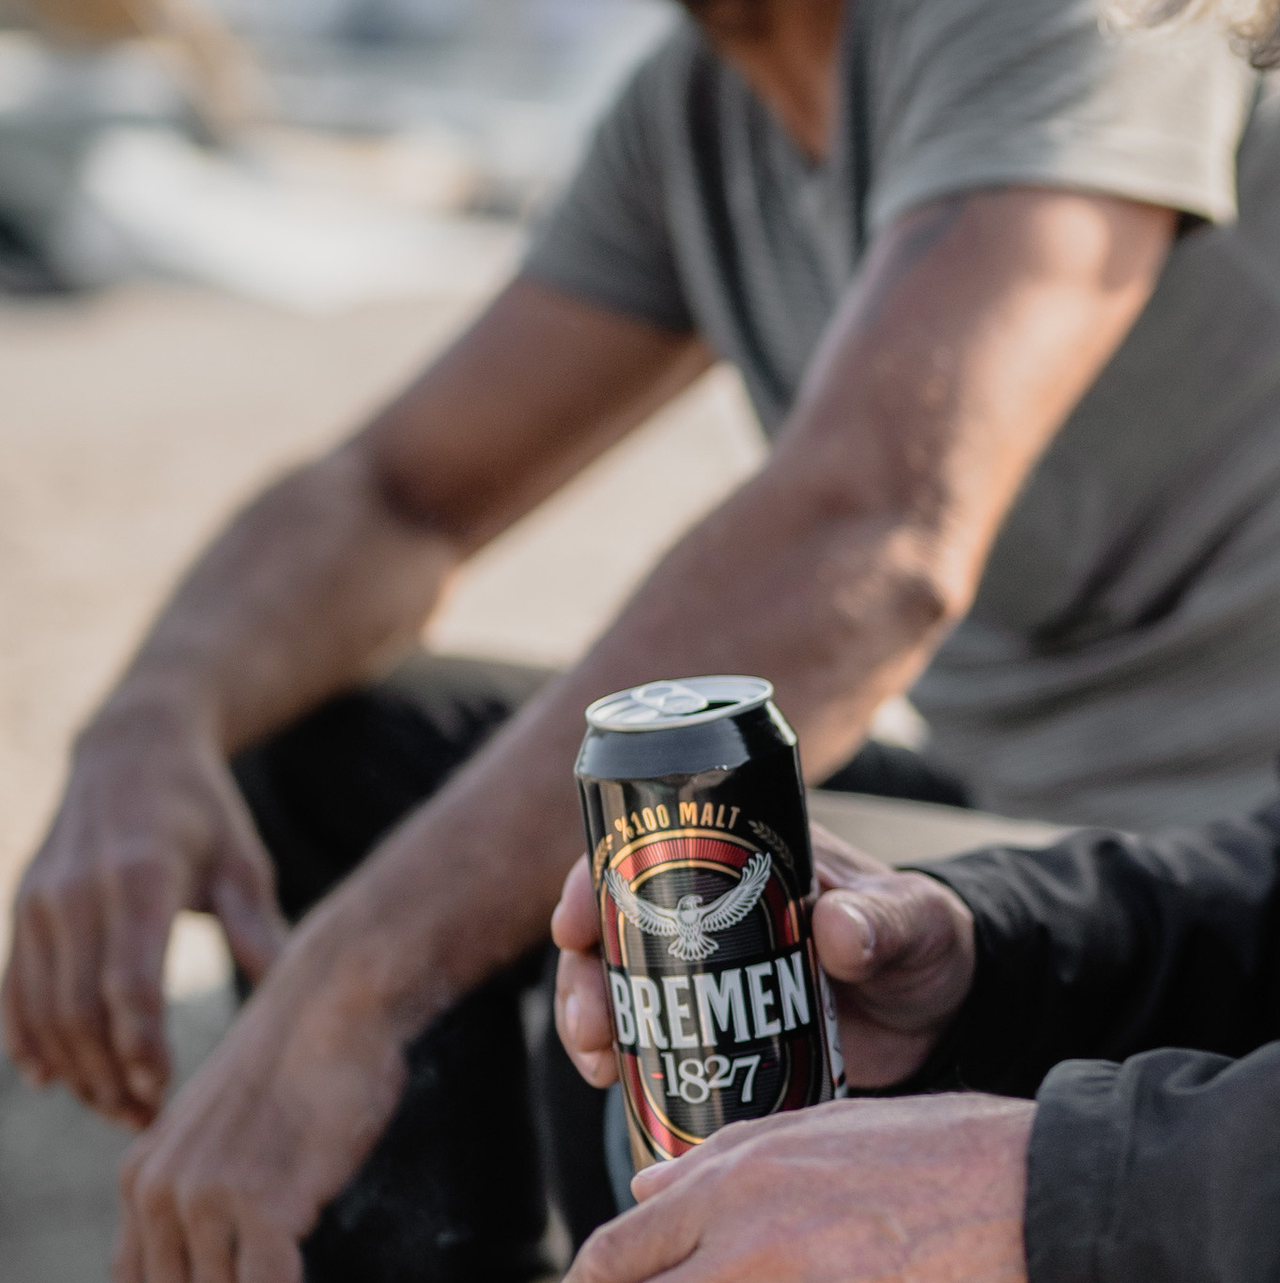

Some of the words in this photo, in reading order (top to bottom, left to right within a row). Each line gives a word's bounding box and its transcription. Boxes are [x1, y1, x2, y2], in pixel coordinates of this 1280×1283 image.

[613, 803, 671, 844] %100
[679, 801, 740, 830] MALT
[609, 950, 811, 1050] BREMEN
[661, 1051, 761, 1104] 1827
